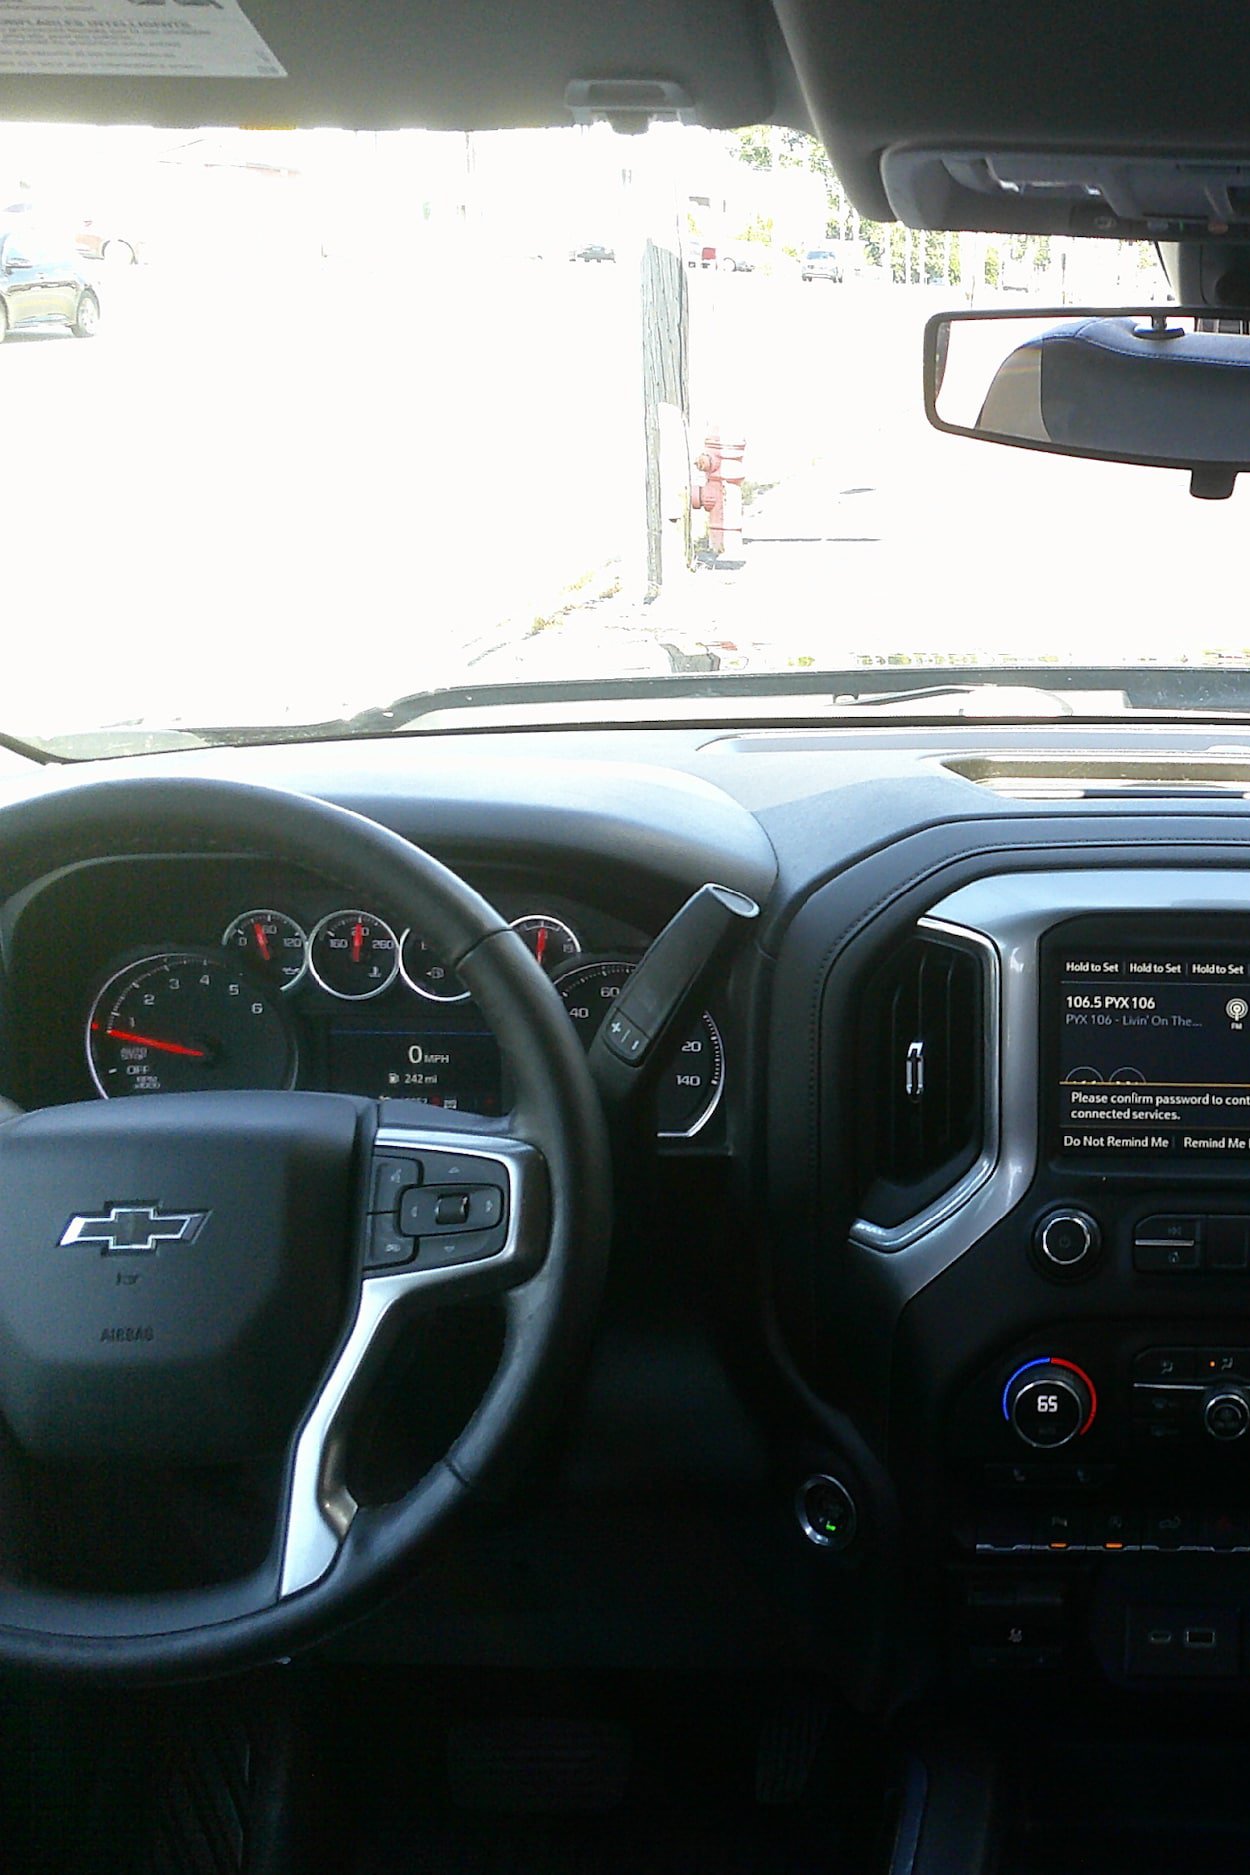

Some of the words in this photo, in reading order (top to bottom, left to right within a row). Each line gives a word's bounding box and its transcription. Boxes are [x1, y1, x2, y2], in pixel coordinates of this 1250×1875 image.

[284, 938, 302, 947] 120
[1066, 961, 1089, 972] Hold
[1091, 963, 1101, 972] to
[1103, 962, 1119, 973] Set
[1129, 962, 1152, 973] Hold
[1153, 964, 1164, 973] to
[1165, 963, 1182, 974] Set
[1192, 963, 1215, 974] Hold
[1216, 965, 1227, 974] to
[1228, 964, 1244, 975] Set
[169, 978, 180, 990] 3
[200, 975, 210, 985] 4
[229, 984, 240, 996] 5
[600, 987, 620, 998] 60
[144, 993, 155, 1005] 2
[1066, 995, 1102, 1008] 106.5
[1105, 996, 1130, 1009] PYX
[1132, 997, 1156, 1010] 106
[251, 1002, 263, 1014] 6
[569, 1007, 589, 1019] 40
[1066, 1014, 1088, 1025] PYX
[1091, 1014, 1112, 1025] 106
[1122, 1015, 1149, 1026] Livin'
[1151, 1016, 1168, 1026] On
[681, 1041, 702, 1053] 20
[408, 1045, 423, 1064] 0
[424, 1054, 450, 1064] MPH
[126, 1065, 149, 1075] OFF
[404, 1074, 423, 1084] 242
[424, 1073, 438, 1084] mi
[676, 1076, 701, 1087] 140
[1071, 1091, 1108, 1104] Please
[1110, 1092, 1153, 1105] confirm
[1155, 1093, 1210, 1107] password
[1211, 1094, 1223, 1105] to
[1070, 1108, 1130, 1120] connected
[1132, 1108, 1181, 1120] services.
[1063, 1135, 1081, 1147] Do
[1083, 1136, 1105, 1147] Not
[1107, 1136, 1149, 1147] Remind
[1151, 1136, 1169, 1148] Me
[1184, 1137, 1225, 1148] Remind
[1228, 1138, 1246, 1149] Me
[101, 1327, 154, 1342] AIRBAG
[1036, 1394, 1059, 1413] 65
